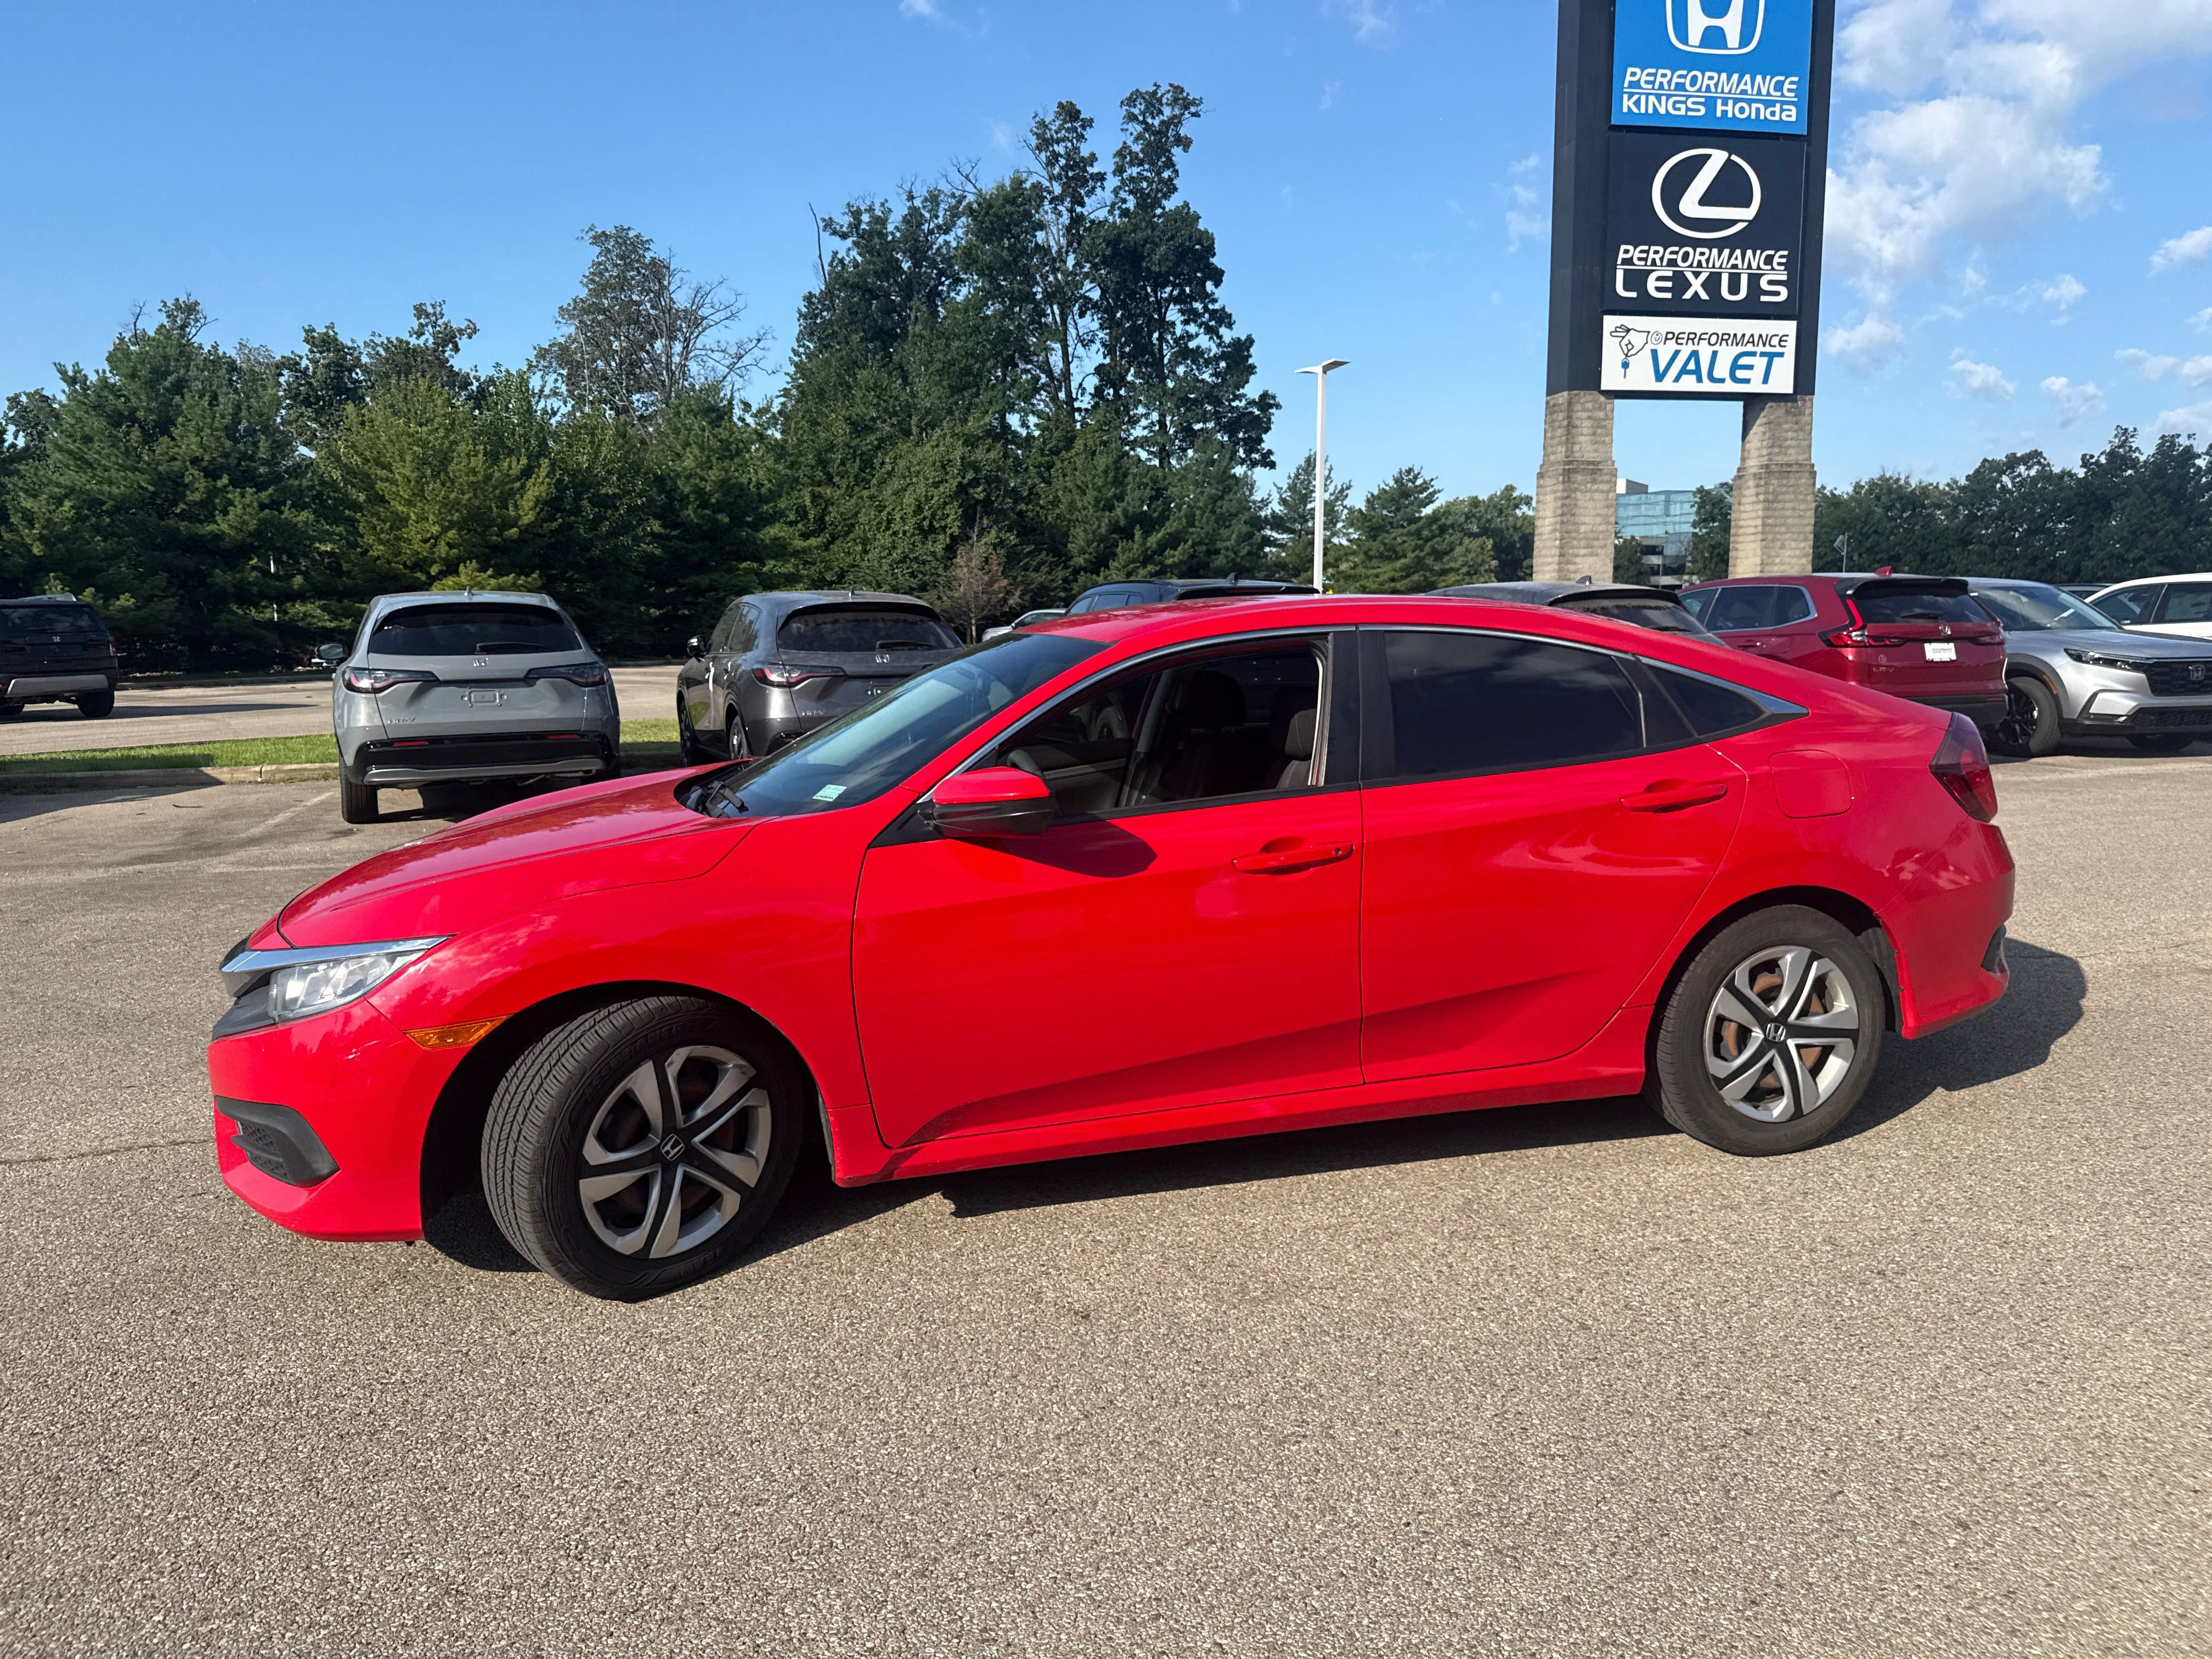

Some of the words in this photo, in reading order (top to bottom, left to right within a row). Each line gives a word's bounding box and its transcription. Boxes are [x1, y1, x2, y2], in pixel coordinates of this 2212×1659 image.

[1623, 67, 1798, 97] PERFORMANCE
[1622, 94, 1706, 116] KINGS
[1716, 99, 1797, 122] Honda
[1617, 245, 1788, 270] PERFORMANCE
[1616, 269, 1788, 302] LEXUS
[1663, 331, 1790, 348] PERFORMANCE
[1650, 349, 1785, 385] VALET
